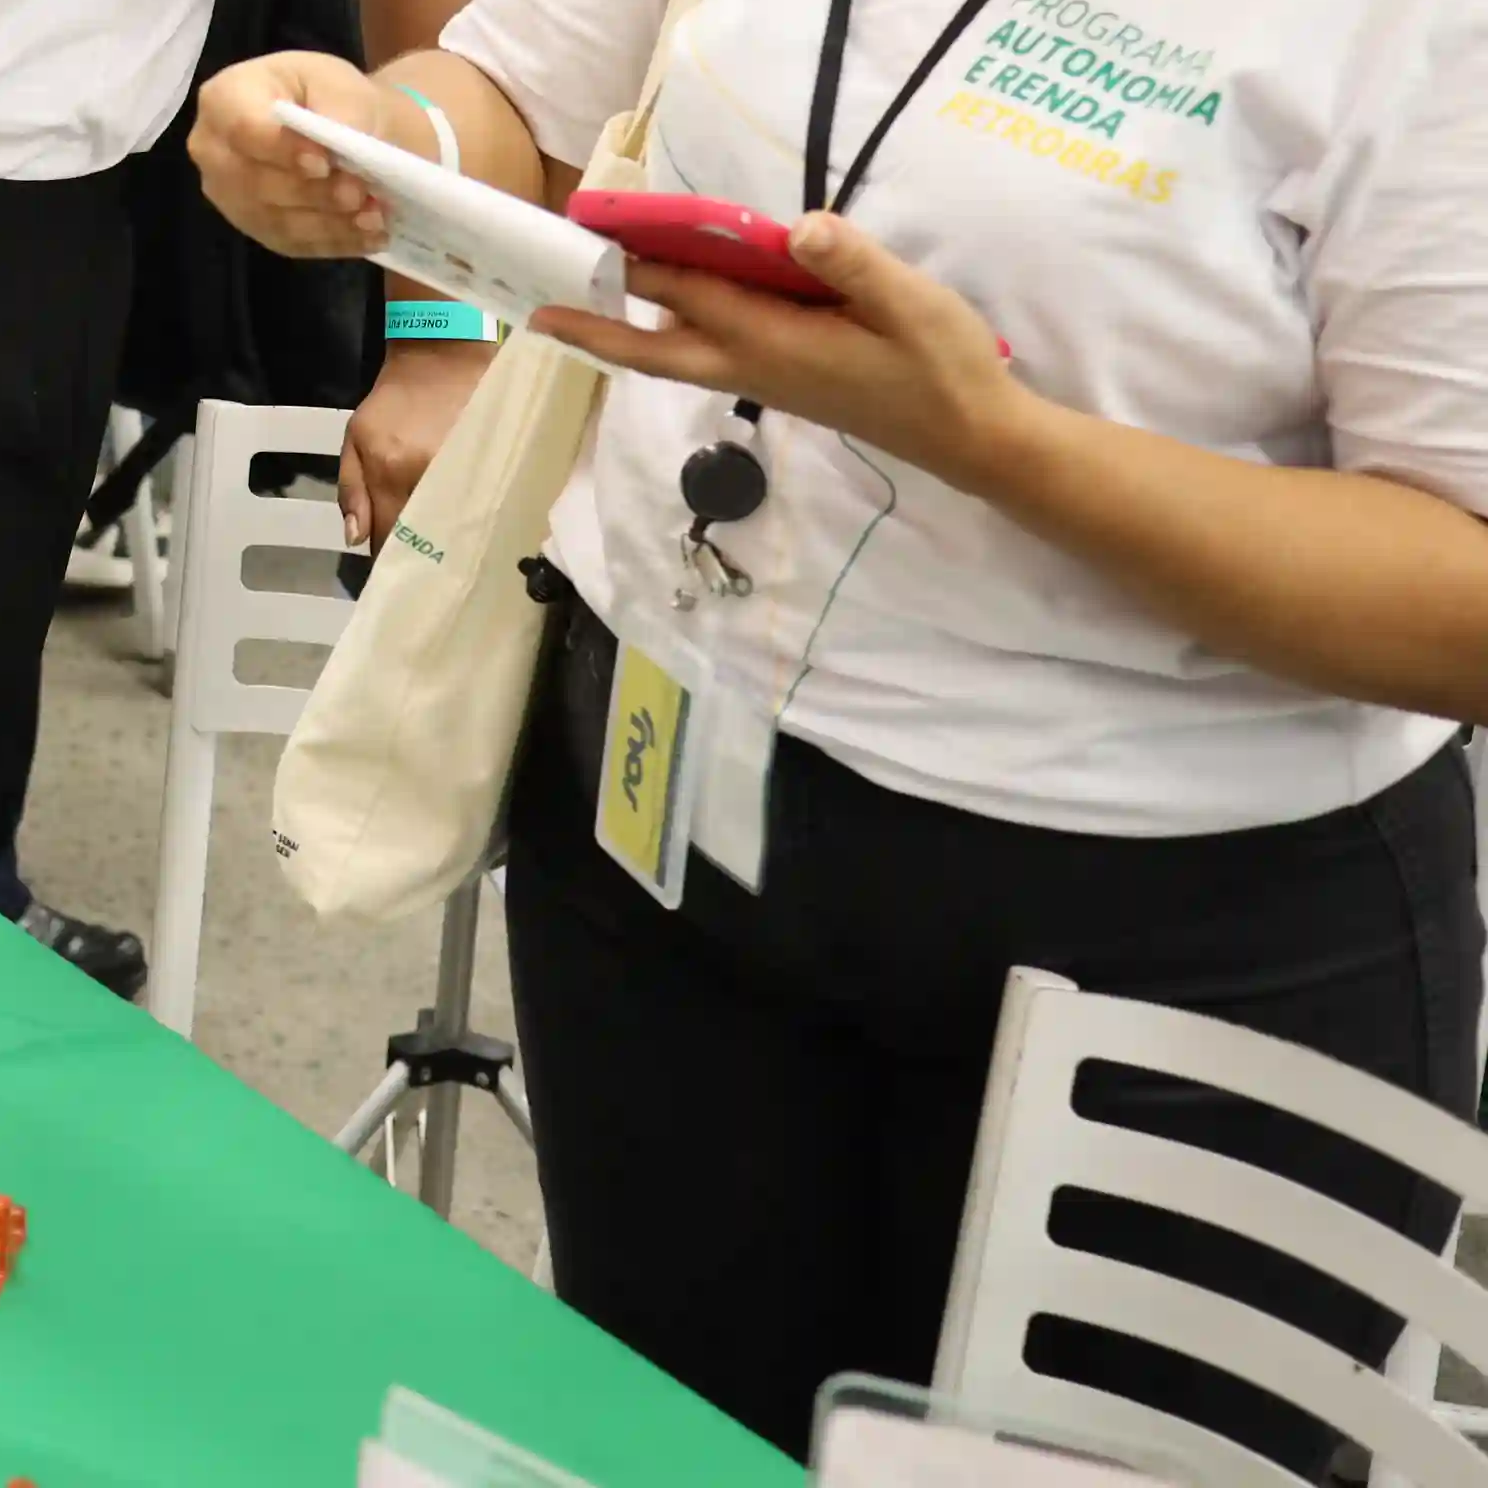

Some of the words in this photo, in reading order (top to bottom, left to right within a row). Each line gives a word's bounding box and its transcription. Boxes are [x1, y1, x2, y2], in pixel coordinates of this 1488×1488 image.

[964, 55, 996, 84] E
[988, 63, 1127, 140] RENDA
[986, 19, 1222, 127] AUTONOMIA
[936, 91, 1181, 204] PETROBRAS
[403, 318, 449, 329] CONECTA
